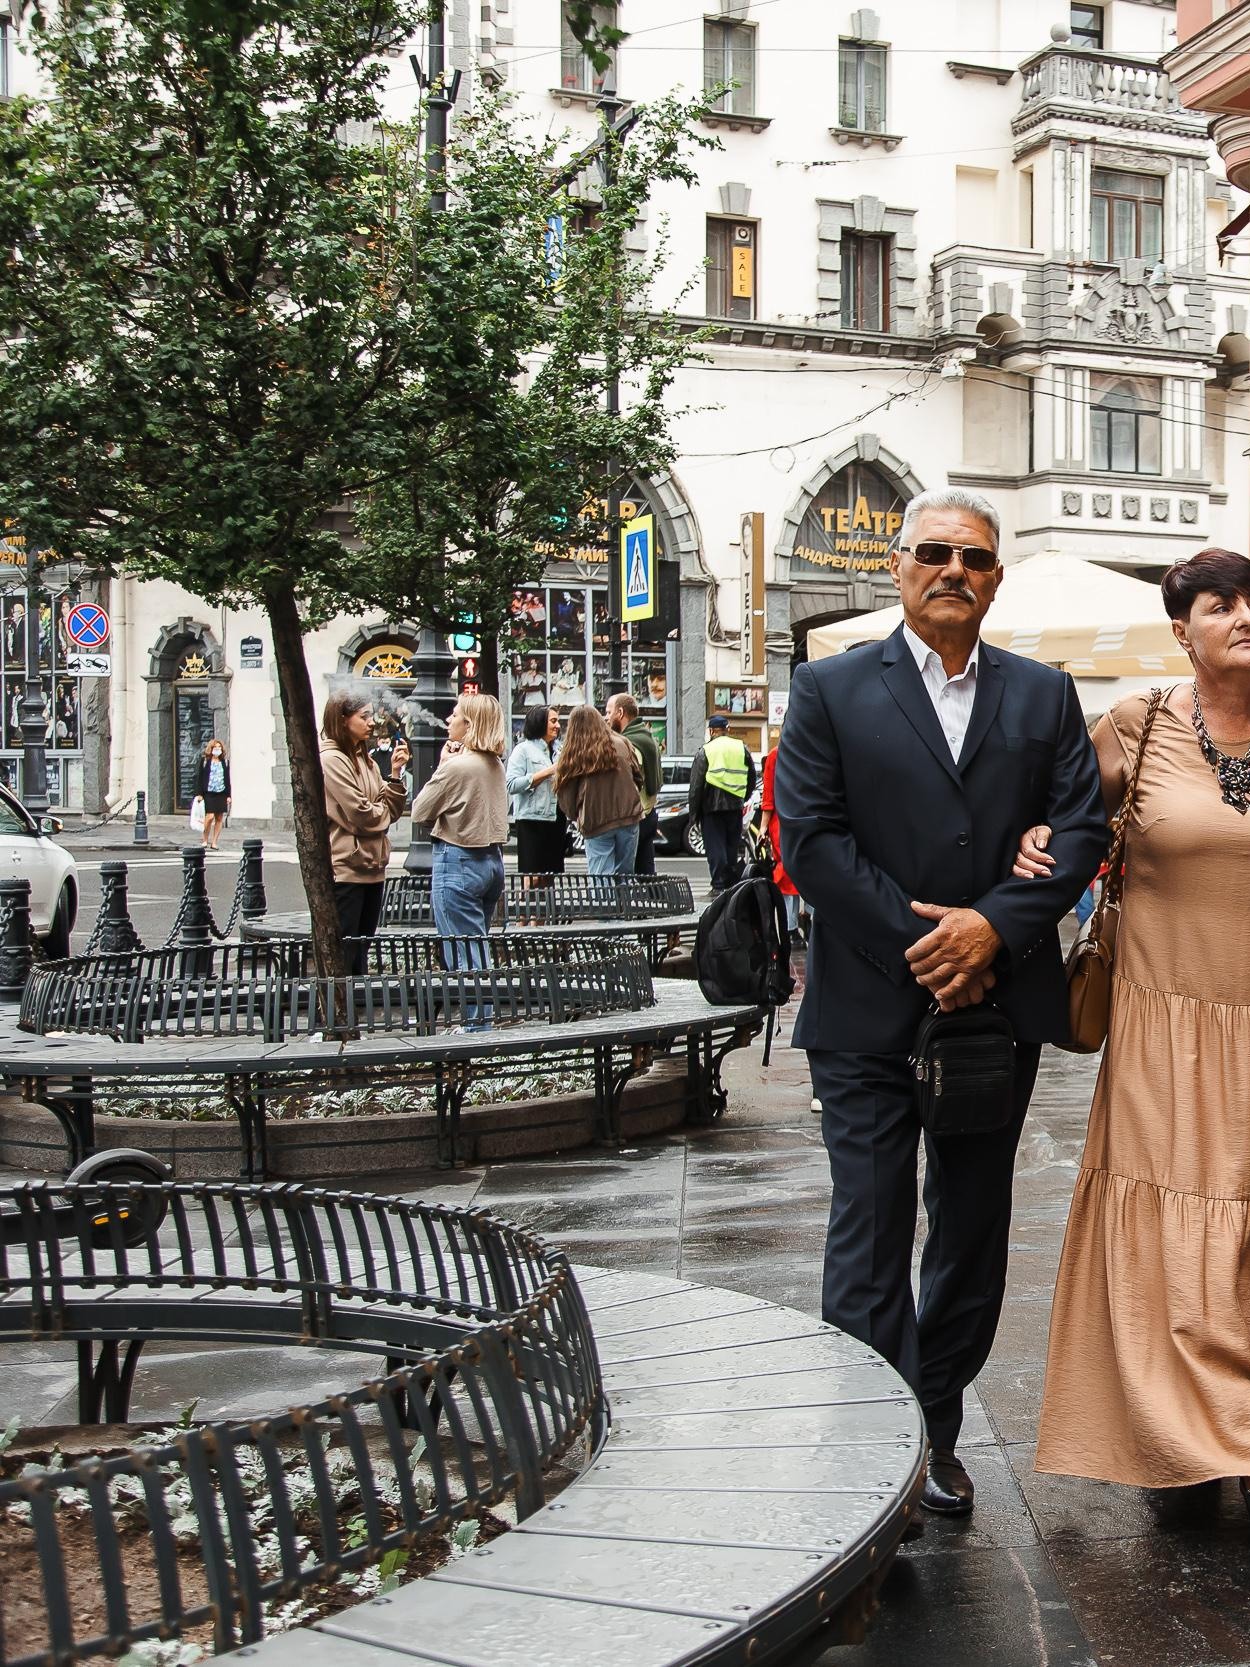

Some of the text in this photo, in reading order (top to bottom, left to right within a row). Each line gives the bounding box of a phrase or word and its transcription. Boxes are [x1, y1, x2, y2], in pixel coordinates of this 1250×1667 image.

[820, 495, 902, 536] ТЕАТР
[794, 545, 892, 571] АНДРЕЯ МИРО
[835, 538, 889, 554] ИМЕНИ
[743, 572, 752, 670] ТЕАТР
